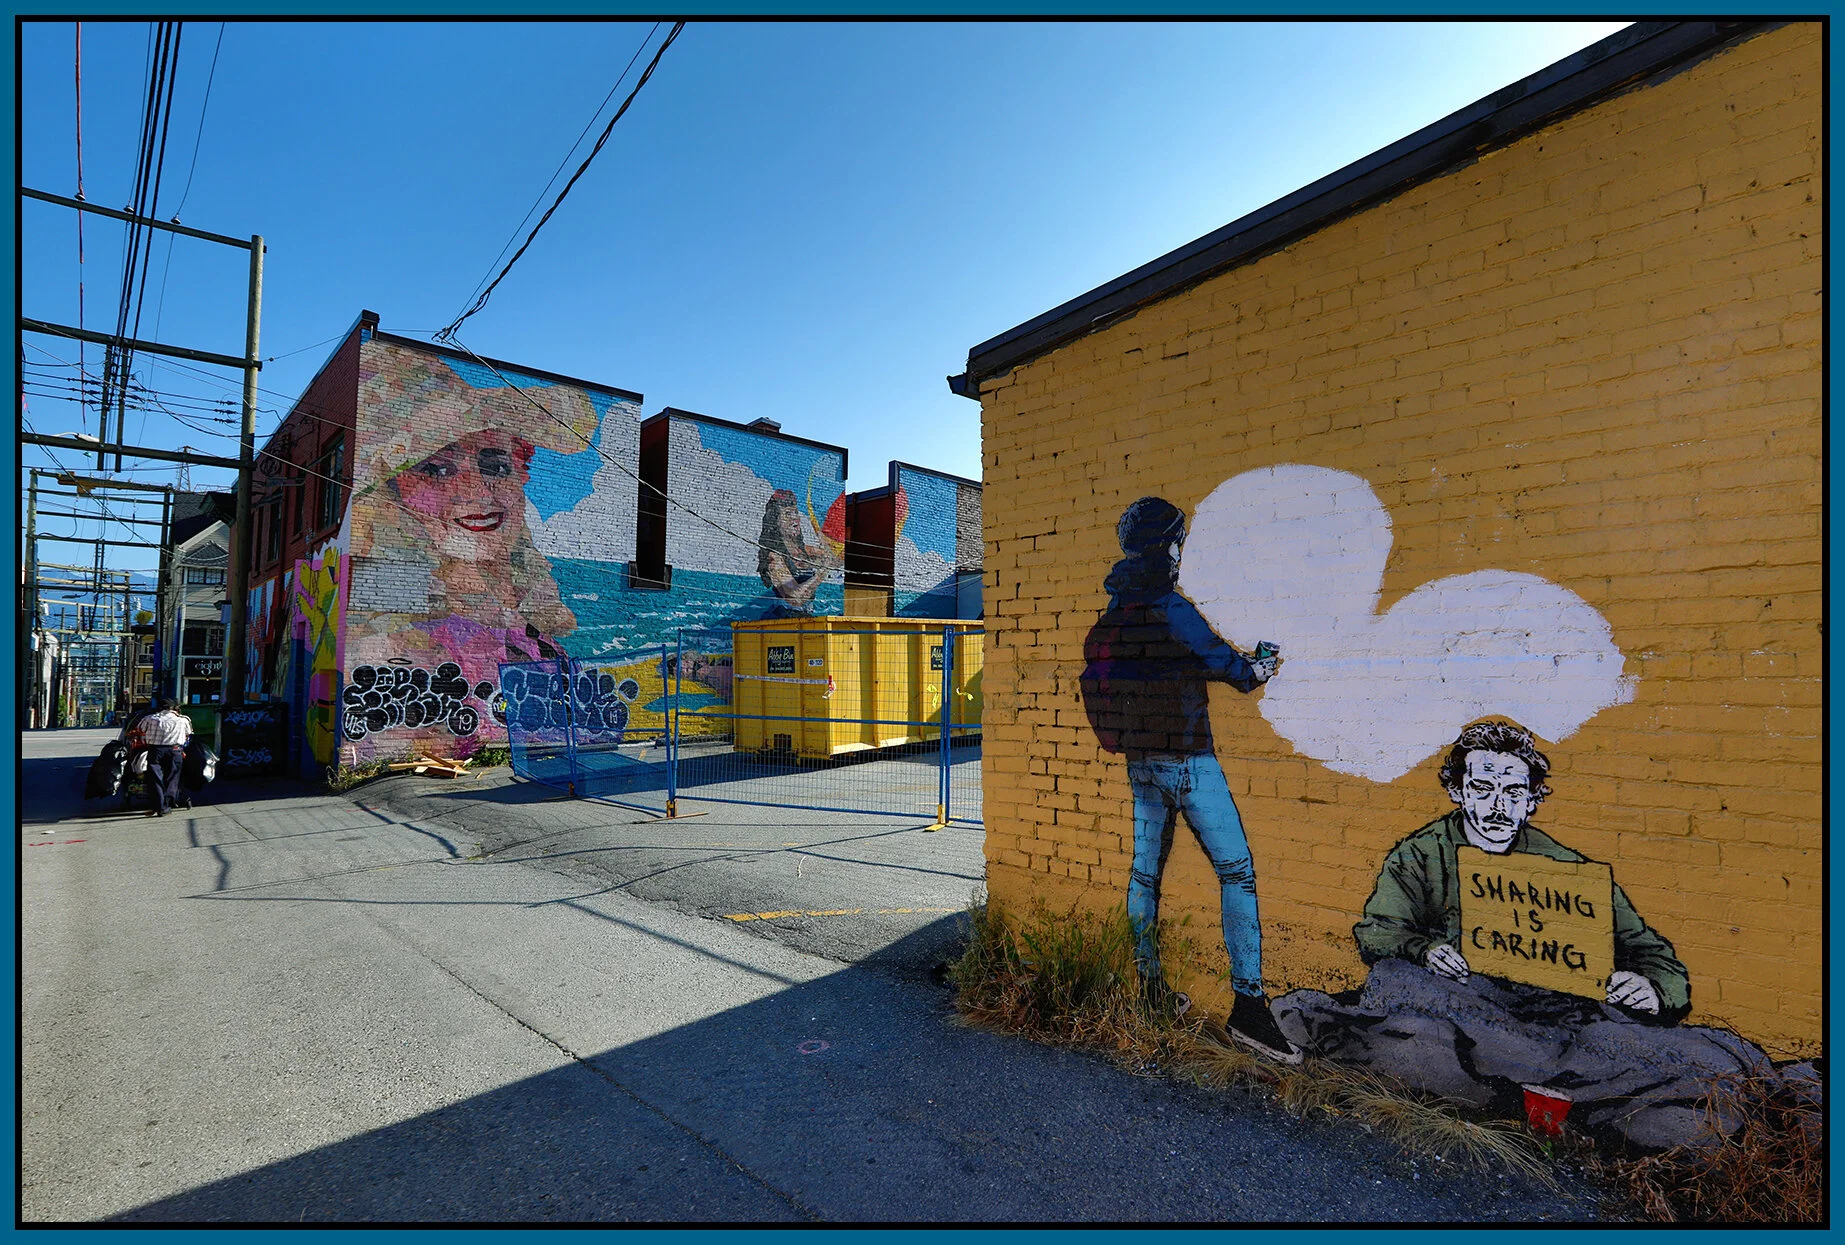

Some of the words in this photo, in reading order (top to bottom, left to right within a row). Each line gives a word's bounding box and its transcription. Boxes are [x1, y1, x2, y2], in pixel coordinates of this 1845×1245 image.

[194, 660, 222, 675] eight
[458, 713, 473, 731] 19
[1470, 873, 1596, 918] SHARING
[1513, 908, 1544, 932] IS
[1471, 926, 1587, 971] CARING
